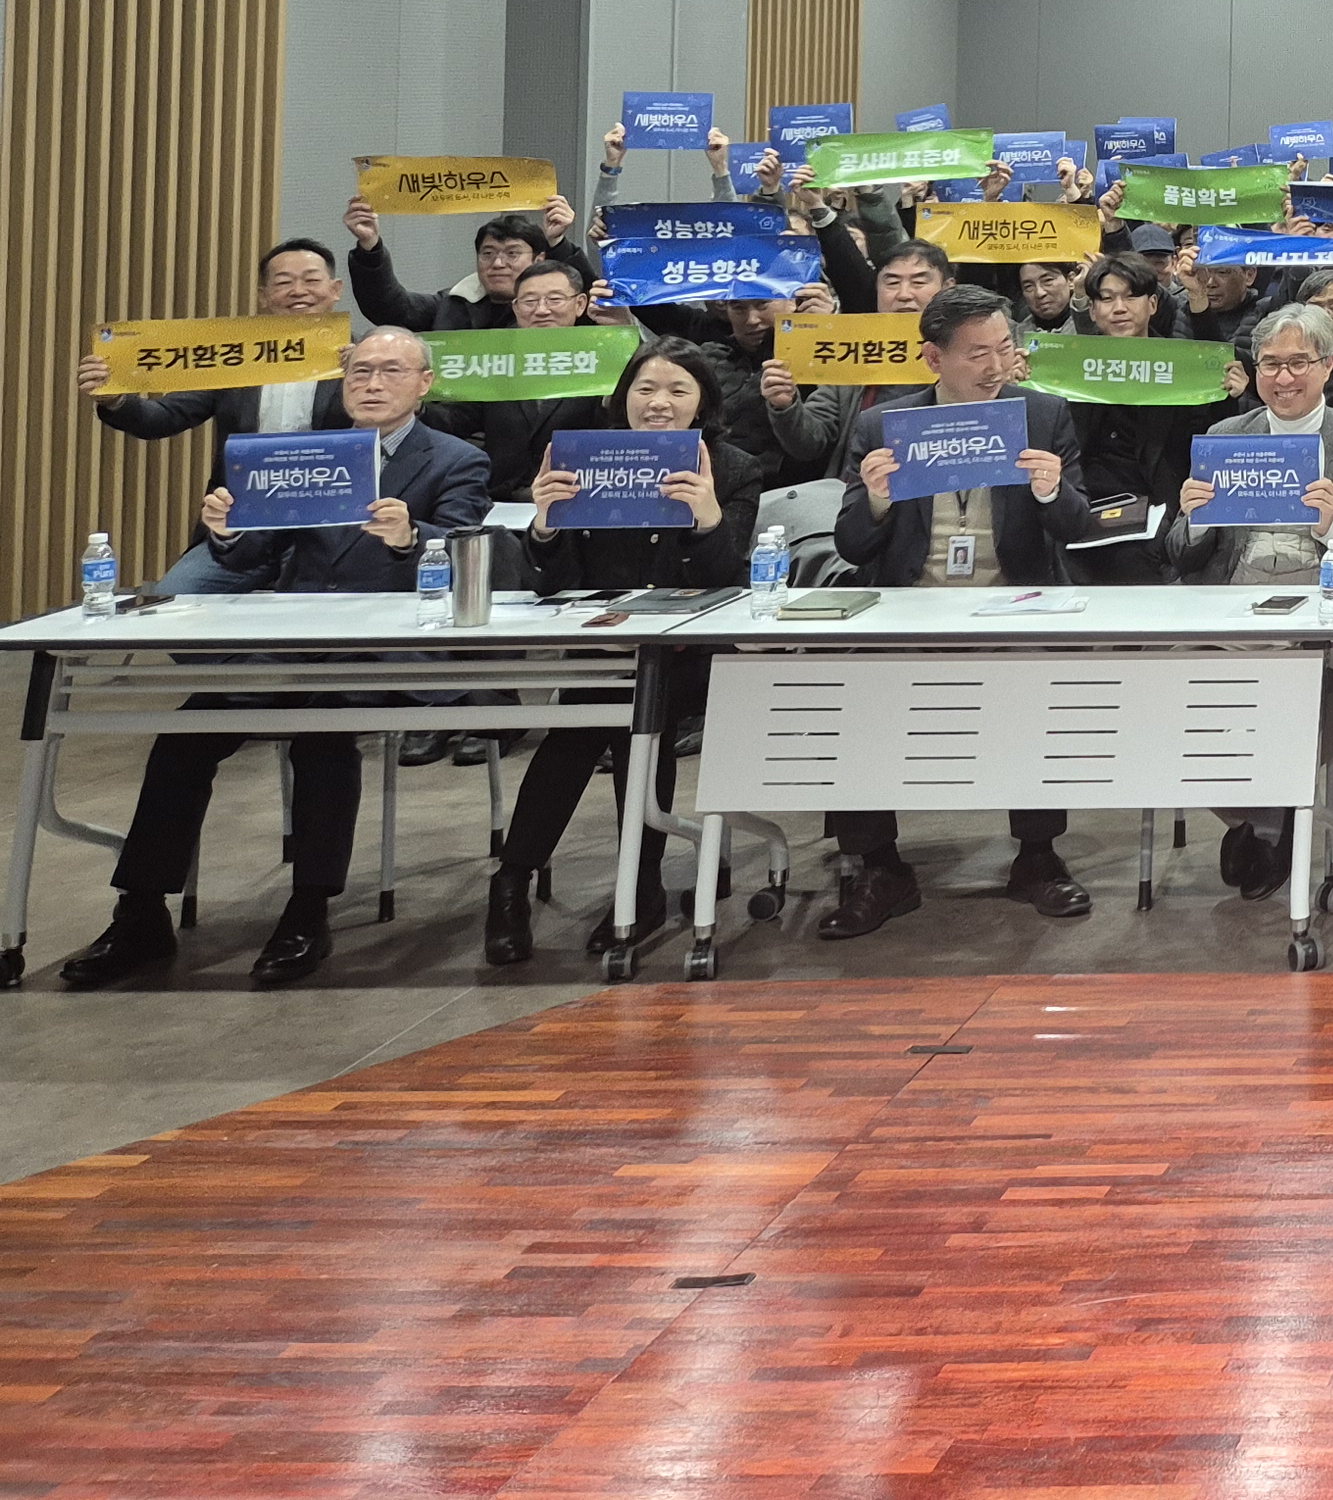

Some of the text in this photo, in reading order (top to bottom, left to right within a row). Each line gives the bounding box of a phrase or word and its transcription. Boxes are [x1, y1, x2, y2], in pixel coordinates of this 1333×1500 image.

[634, 113, 698, 132] 새빛하우스
[1280, 134, 1325, 148] 새빛하우스
[839, 148, 961, 172] 공사비 표준화
[1000, 150, 1052, 167] 새빛하우스
[398, 170, 510, 201] 새빛하우스
[1164, 185, 1237, 207] 품질확보
[958, 219, 1057, 248] 새빛하우스
[662, 258, 760, 284] 성능향상
[137, 337, 306, 371] 주거환경 개선
[440, 350, 598, 379] 공사비 표준화
[814, 340, 908, 364] 주거환경
[1082, 358, 1174, 384] 안전제일
[907, 435, 1007, 467] 새빛하우스
[246, 466, 352, 499] 새빛하우스
[1212, 468, 1300, 497] 새빛하우스
